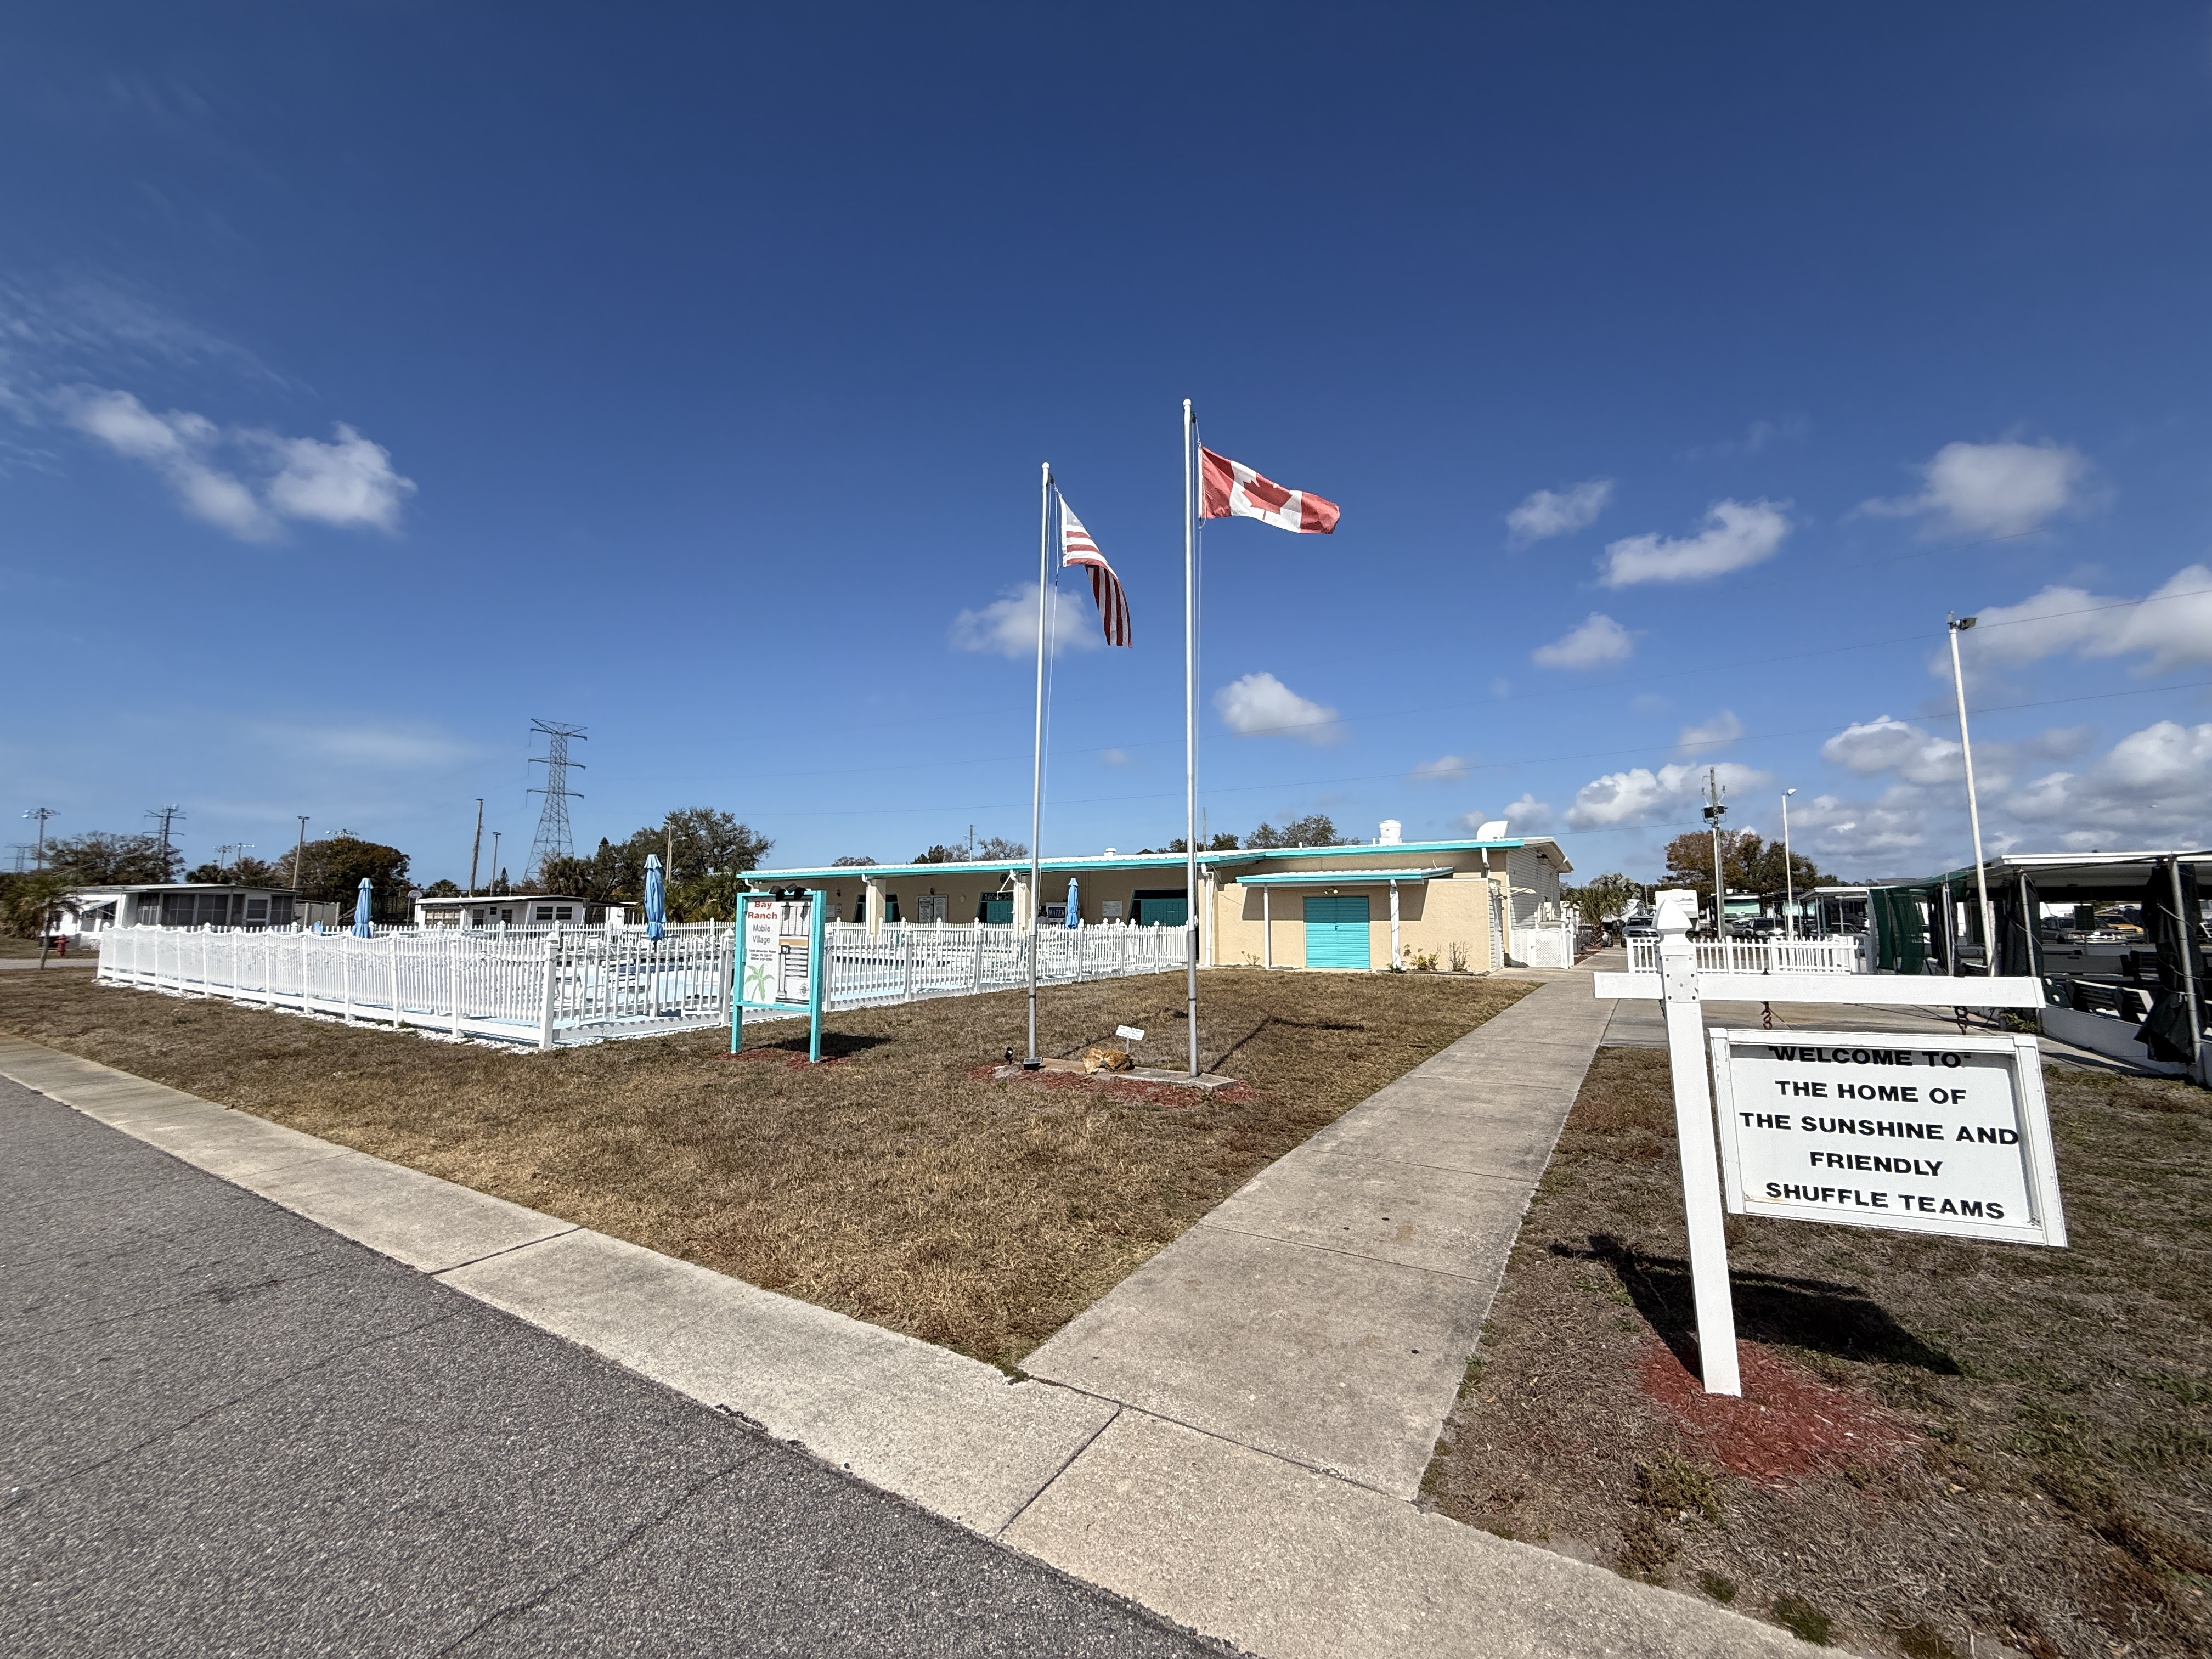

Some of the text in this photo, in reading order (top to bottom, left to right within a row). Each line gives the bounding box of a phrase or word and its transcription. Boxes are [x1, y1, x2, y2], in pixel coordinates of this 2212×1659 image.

[754, 900, 772, 910] Bay
[752, 935, 770, 945] Village
[753, 924, 771, 932] Mobile
[1775, 1080, 1966, 1104] THE HOME OF
[1739, 1112, 2019, 1145] THE SUNSHINE AND
[1810, 1152, 1943, 1176] FRIENDLY
[1765, 1182, 2005, 1219] SHUFFLE TEAMS
